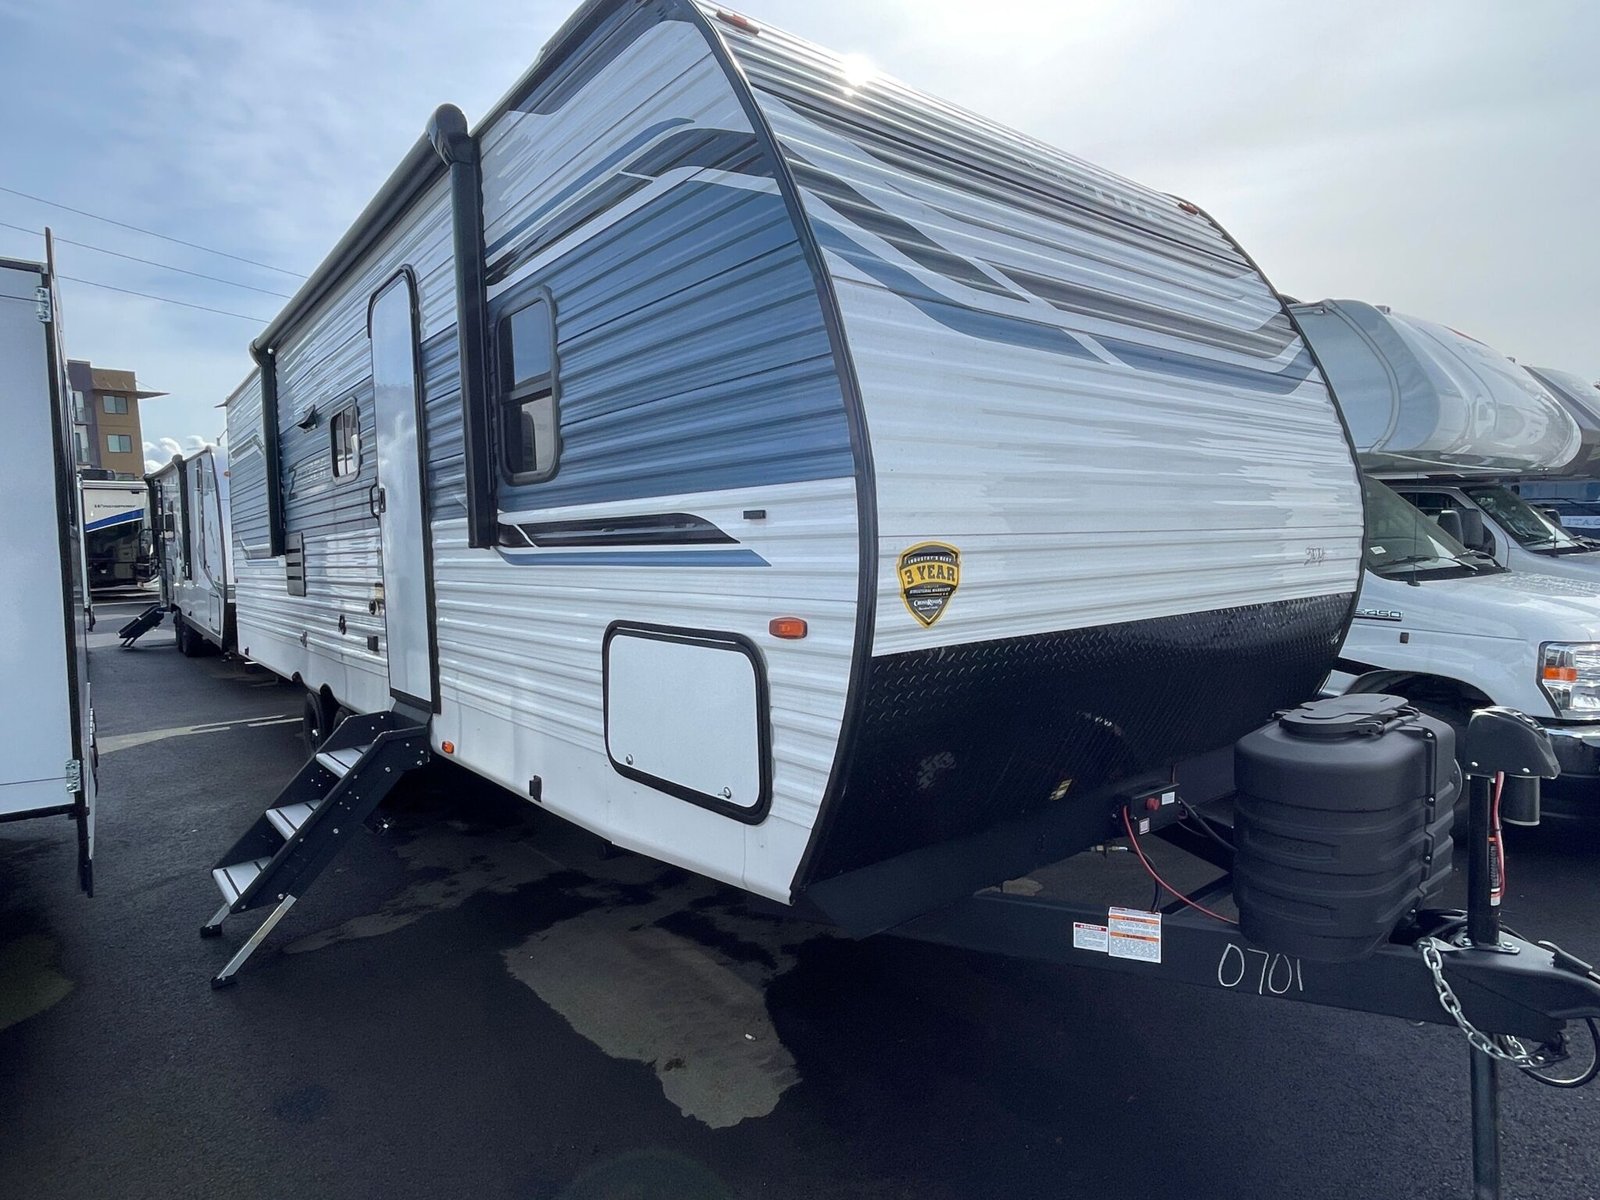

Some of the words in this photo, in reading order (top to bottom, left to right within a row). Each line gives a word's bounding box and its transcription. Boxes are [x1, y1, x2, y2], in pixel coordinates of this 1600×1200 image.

[904, 569, 914, 585] 3
[916, 564, 956, 582] YEAR
[1218, 943, 1304, 995] 0701
